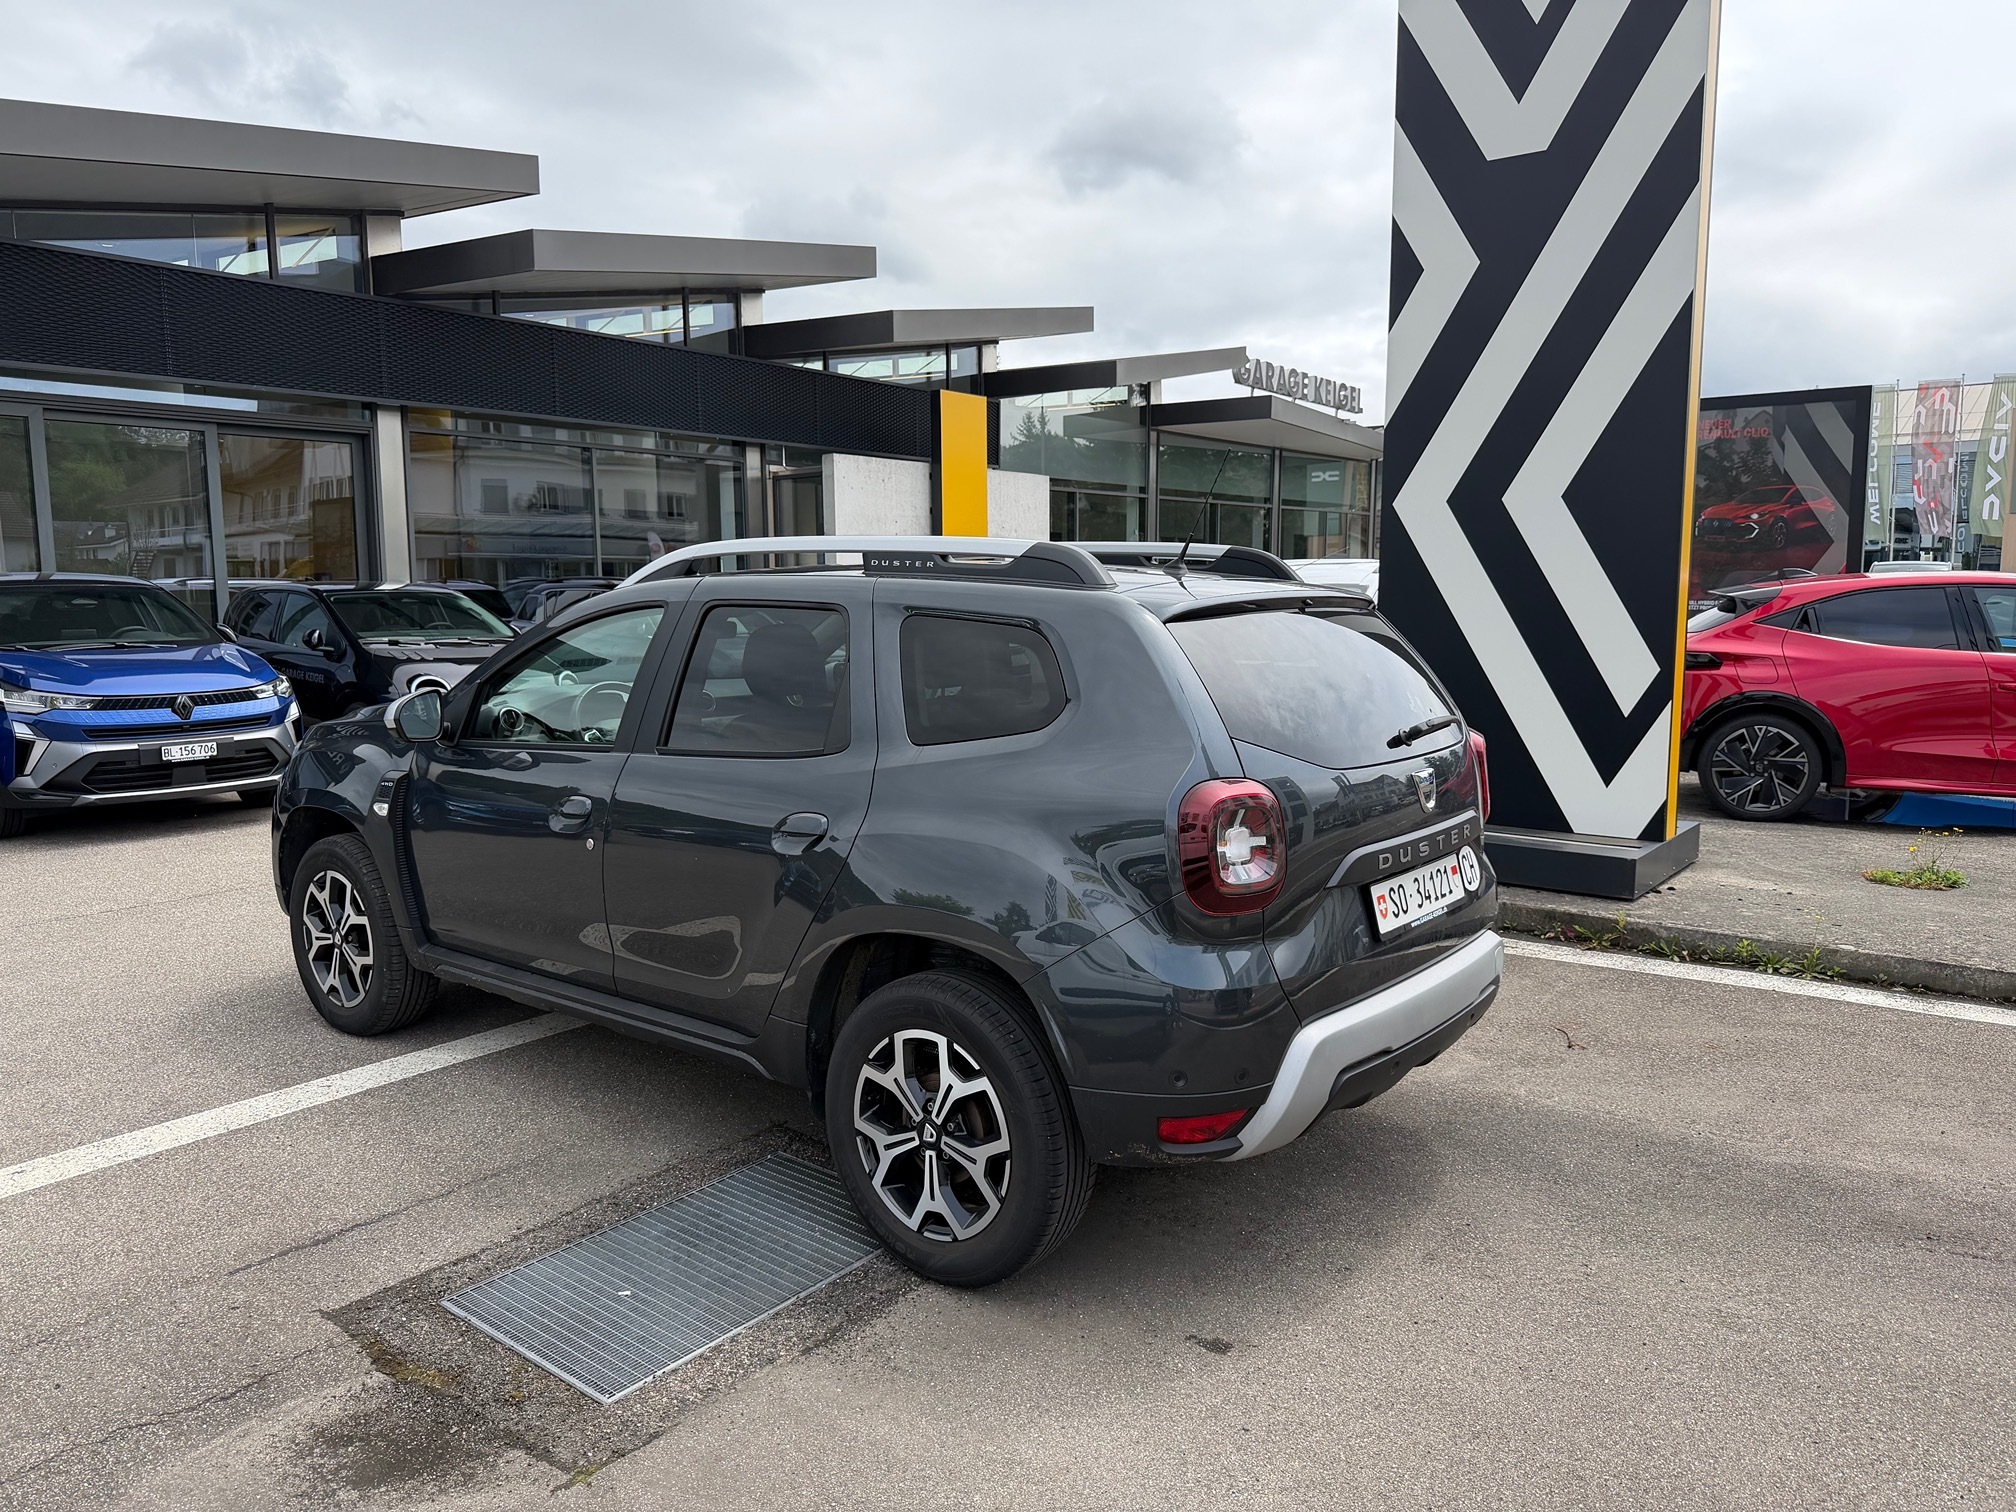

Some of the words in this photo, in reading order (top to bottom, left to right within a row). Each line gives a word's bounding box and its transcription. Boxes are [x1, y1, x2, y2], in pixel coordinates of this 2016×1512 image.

[1233, 358, 1309, 400] GARAGE
[1309, 376, 1363, 413] KEIGEL
[1698, 428, 1742, 439] RENAULT
[1744, 427, 1769, 438] CLIO
[870, 559, 935, 568] DUSTER
[281, 667, 305, 680] GARAGE
[305, 671, 325, 684] KEIGEL
[1378, 823, 1471, 870] DUSTER
[1461, 850, 1479, 886] CH
